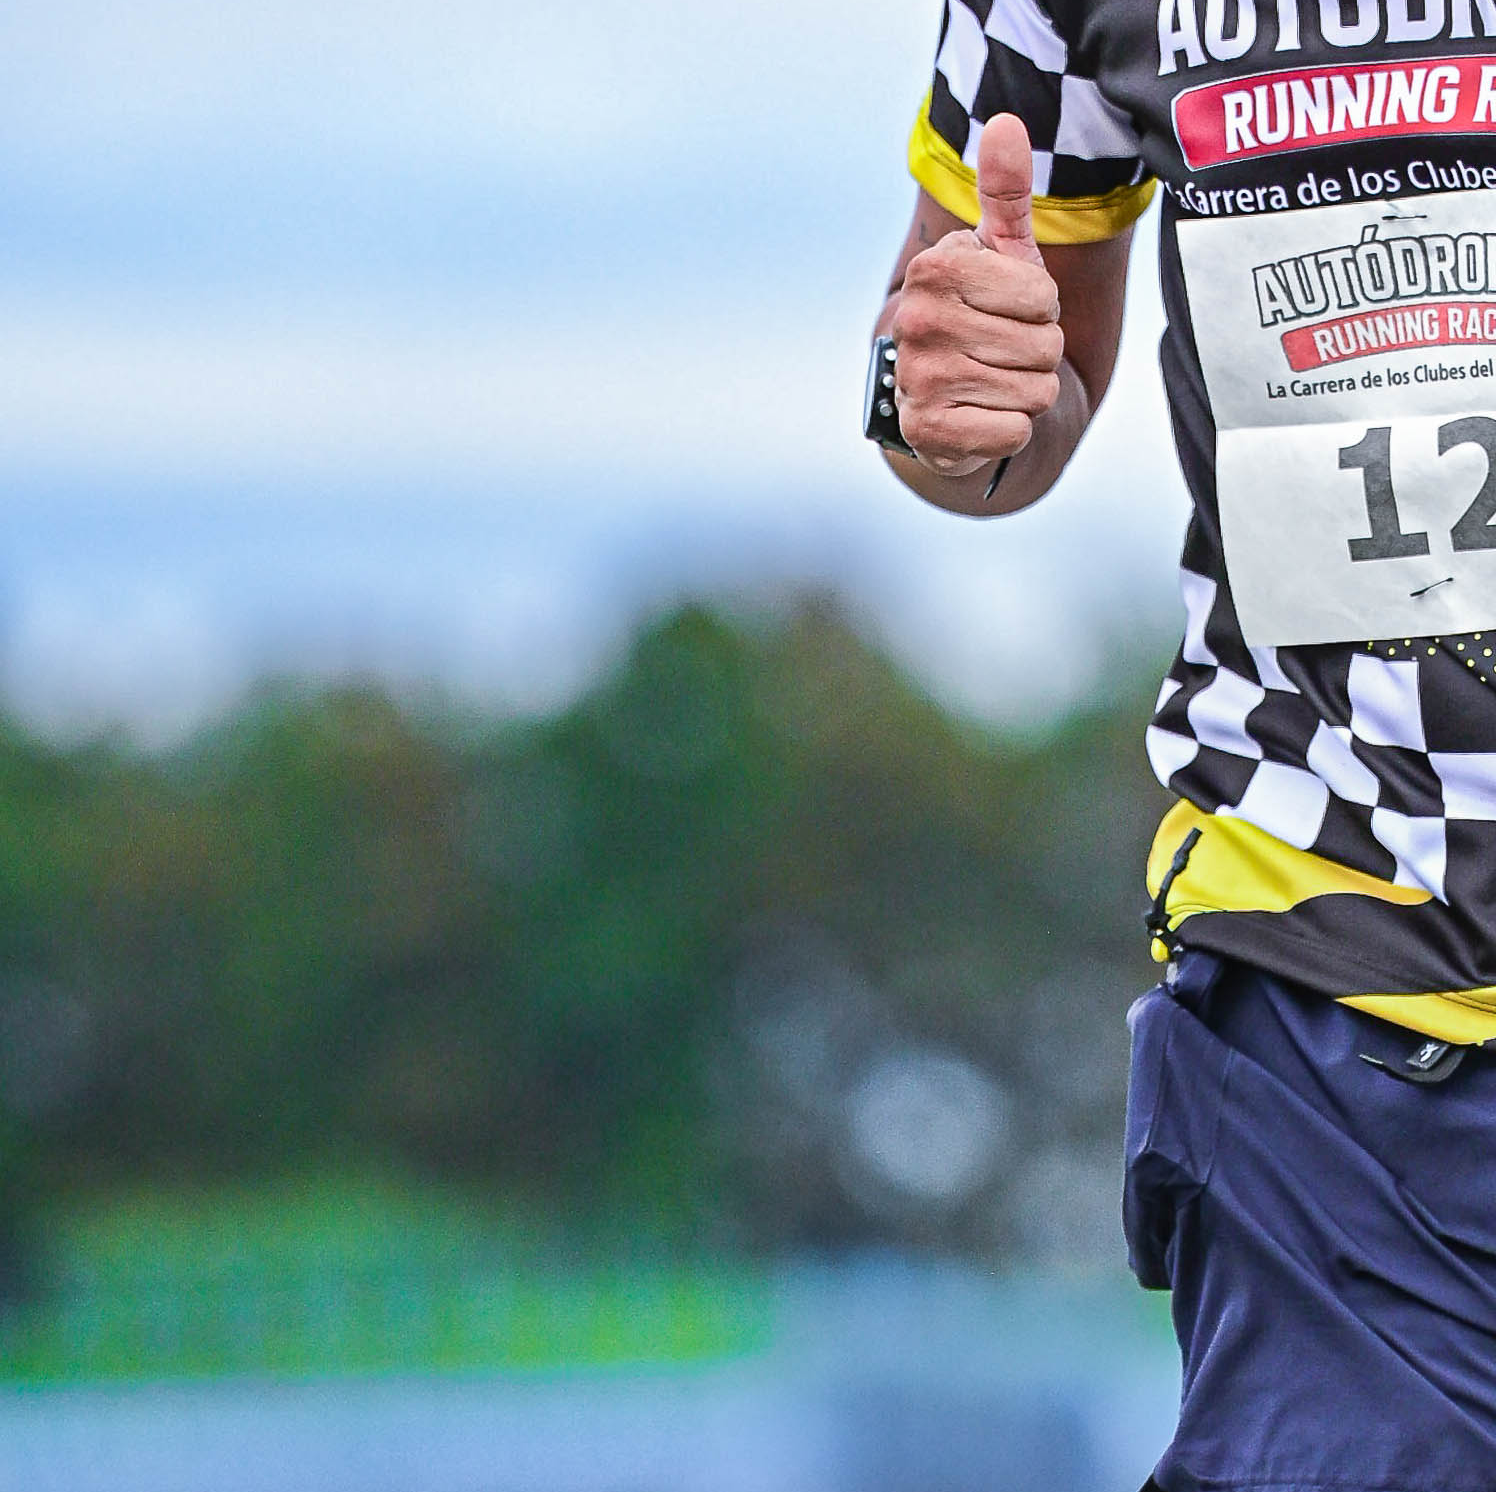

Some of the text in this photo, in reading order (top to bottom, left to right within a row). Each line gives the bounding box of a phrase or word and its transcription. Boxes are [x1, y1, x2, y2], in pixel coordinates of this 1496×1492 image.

[1222, 64, 1461, 154] RUNNING
[1184, 181, 1289, 215] Carrera
[1296, 172, 1342, 206] de
[1348, 167, 1401, 197] los
[1312, 308, 1440, 362] RUNNING
[1266, 382, 1287, 400] La
[1290, 377, 1356, 398] Carrera
[1361, 370, 1383, 389] de
[1387, 367, 1410, 386] los
[1413, 364, 1467, 384] Clubes
[1470, 359, 1494, 379] del
